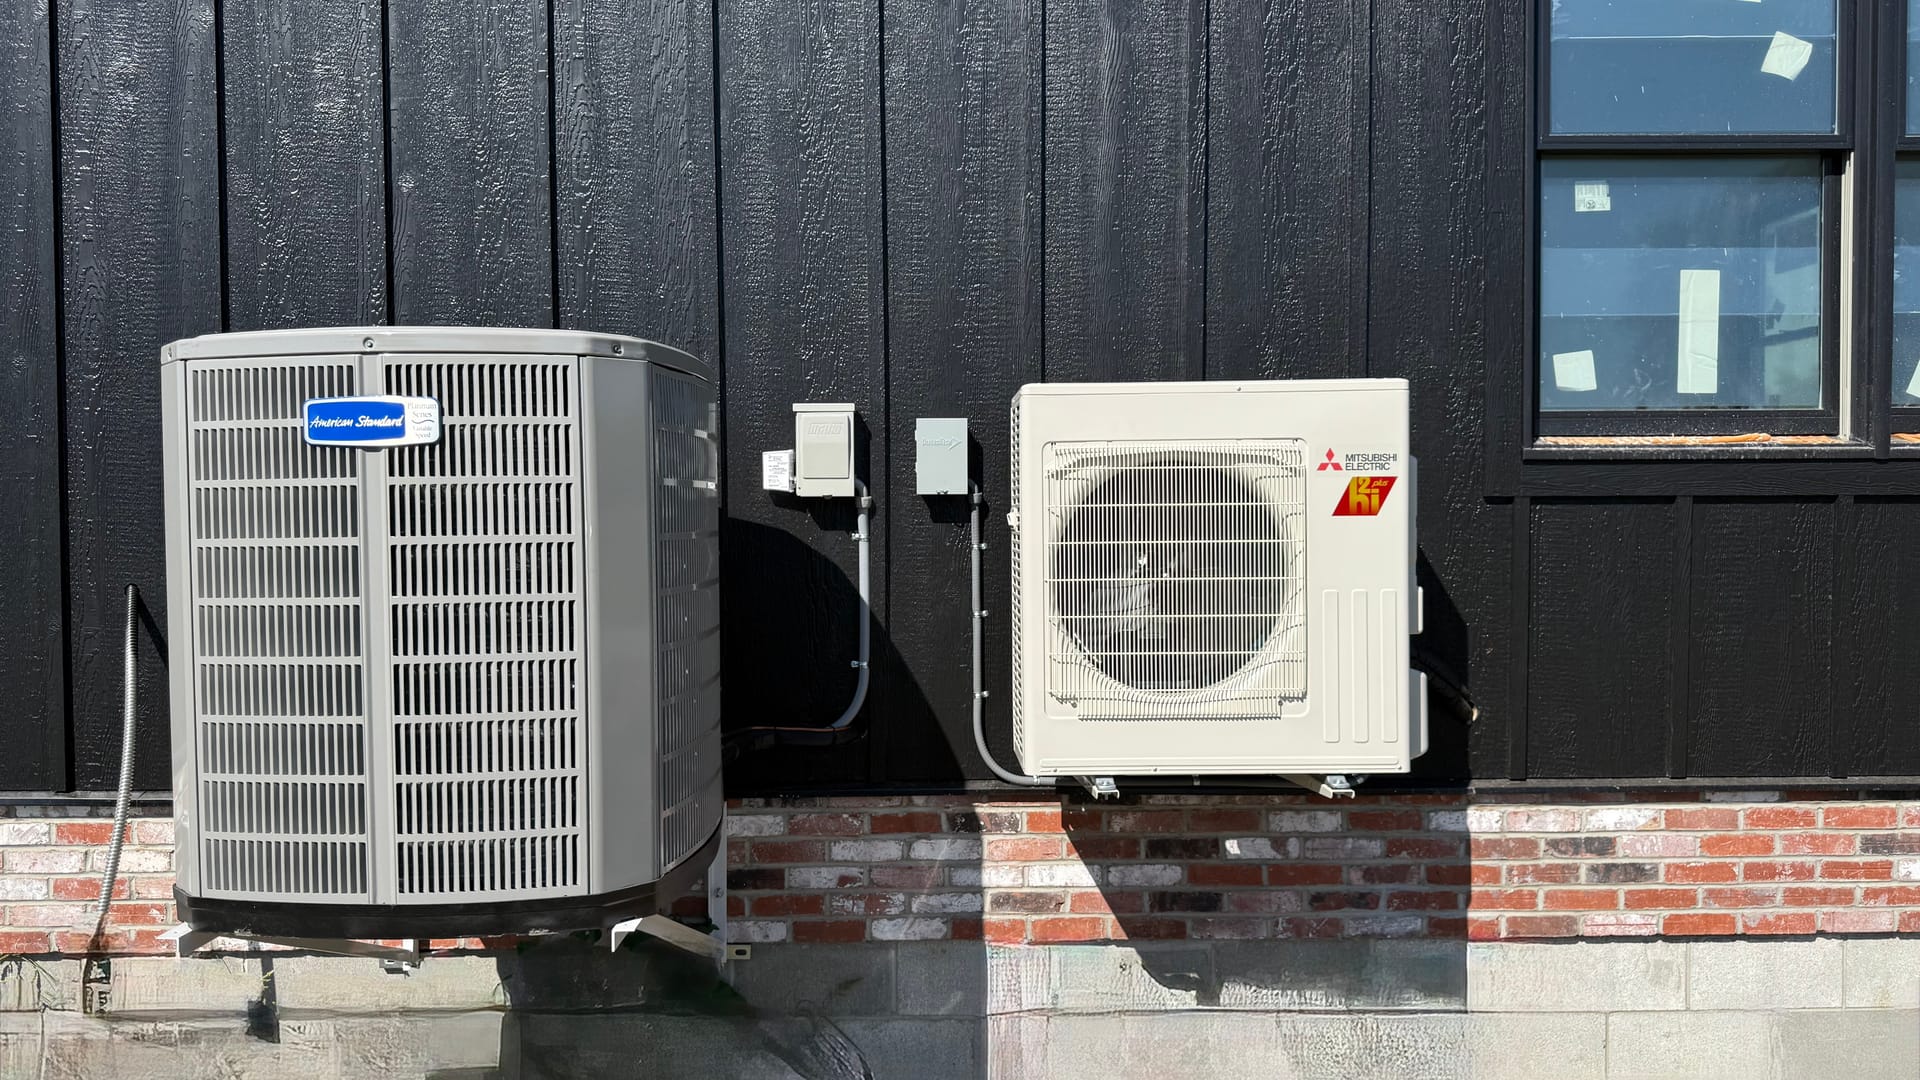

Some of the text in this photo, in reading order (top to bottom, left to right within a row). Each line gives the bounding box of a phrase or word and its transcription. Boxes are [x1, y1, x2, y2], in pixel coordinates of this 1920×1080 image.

[309, 414, 405, 428] American Standard
[1345, 453, 1397, 462] MITSUBISHI
[1345, 462, 1390, 471] ELECTRIC
